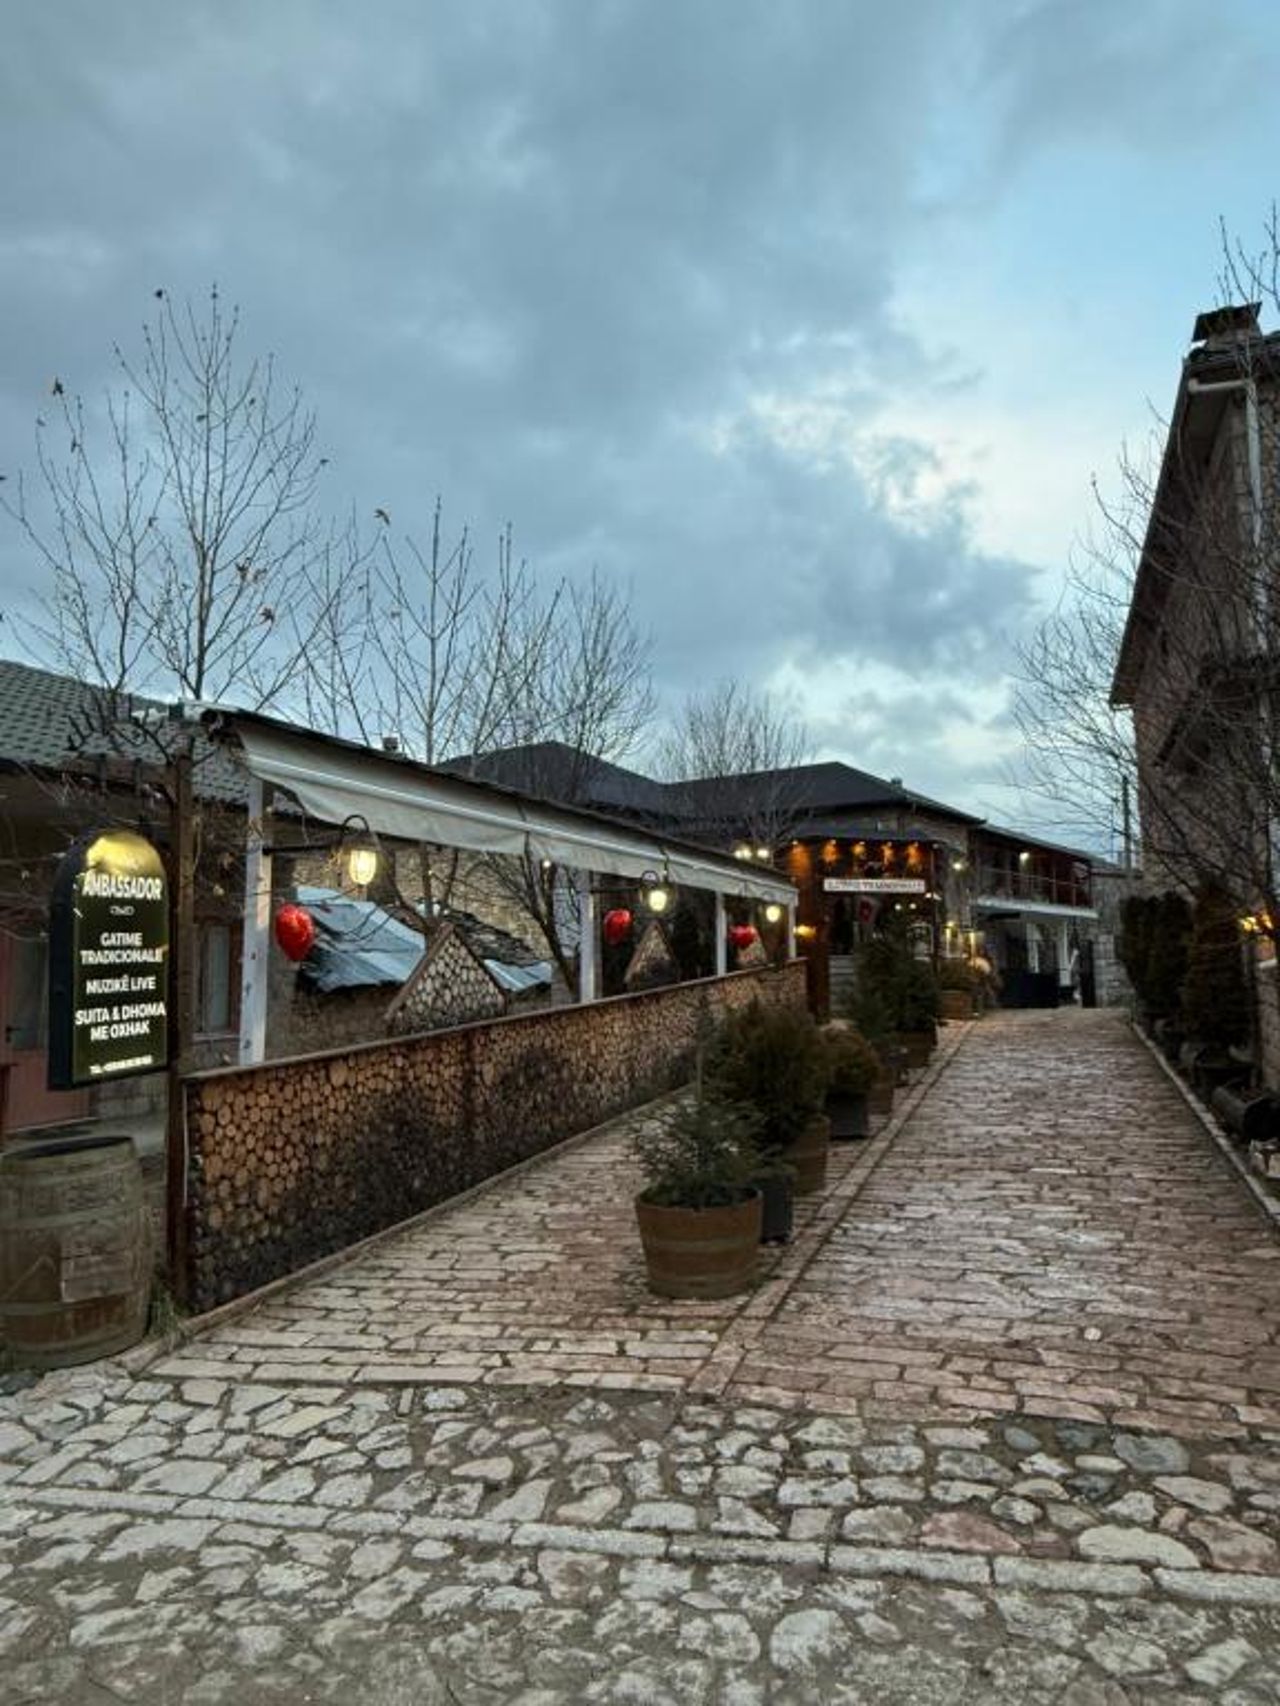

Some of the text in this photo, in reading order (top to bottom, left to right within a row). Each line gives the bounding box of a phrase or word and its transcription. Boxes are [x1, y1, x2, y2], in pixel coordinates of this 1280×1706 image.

[82, 869, 162, 900] AMBASSADOR
[100, 932, 143, 946] GATIME
[80, 948, 163, 965] TRADICIONALE
[130, 975, 156, 991] LIVE
[75, 1002, 166, 1025] SUITA & DHOMA
[90, 1020, 150, 1041] ME OXHAK
